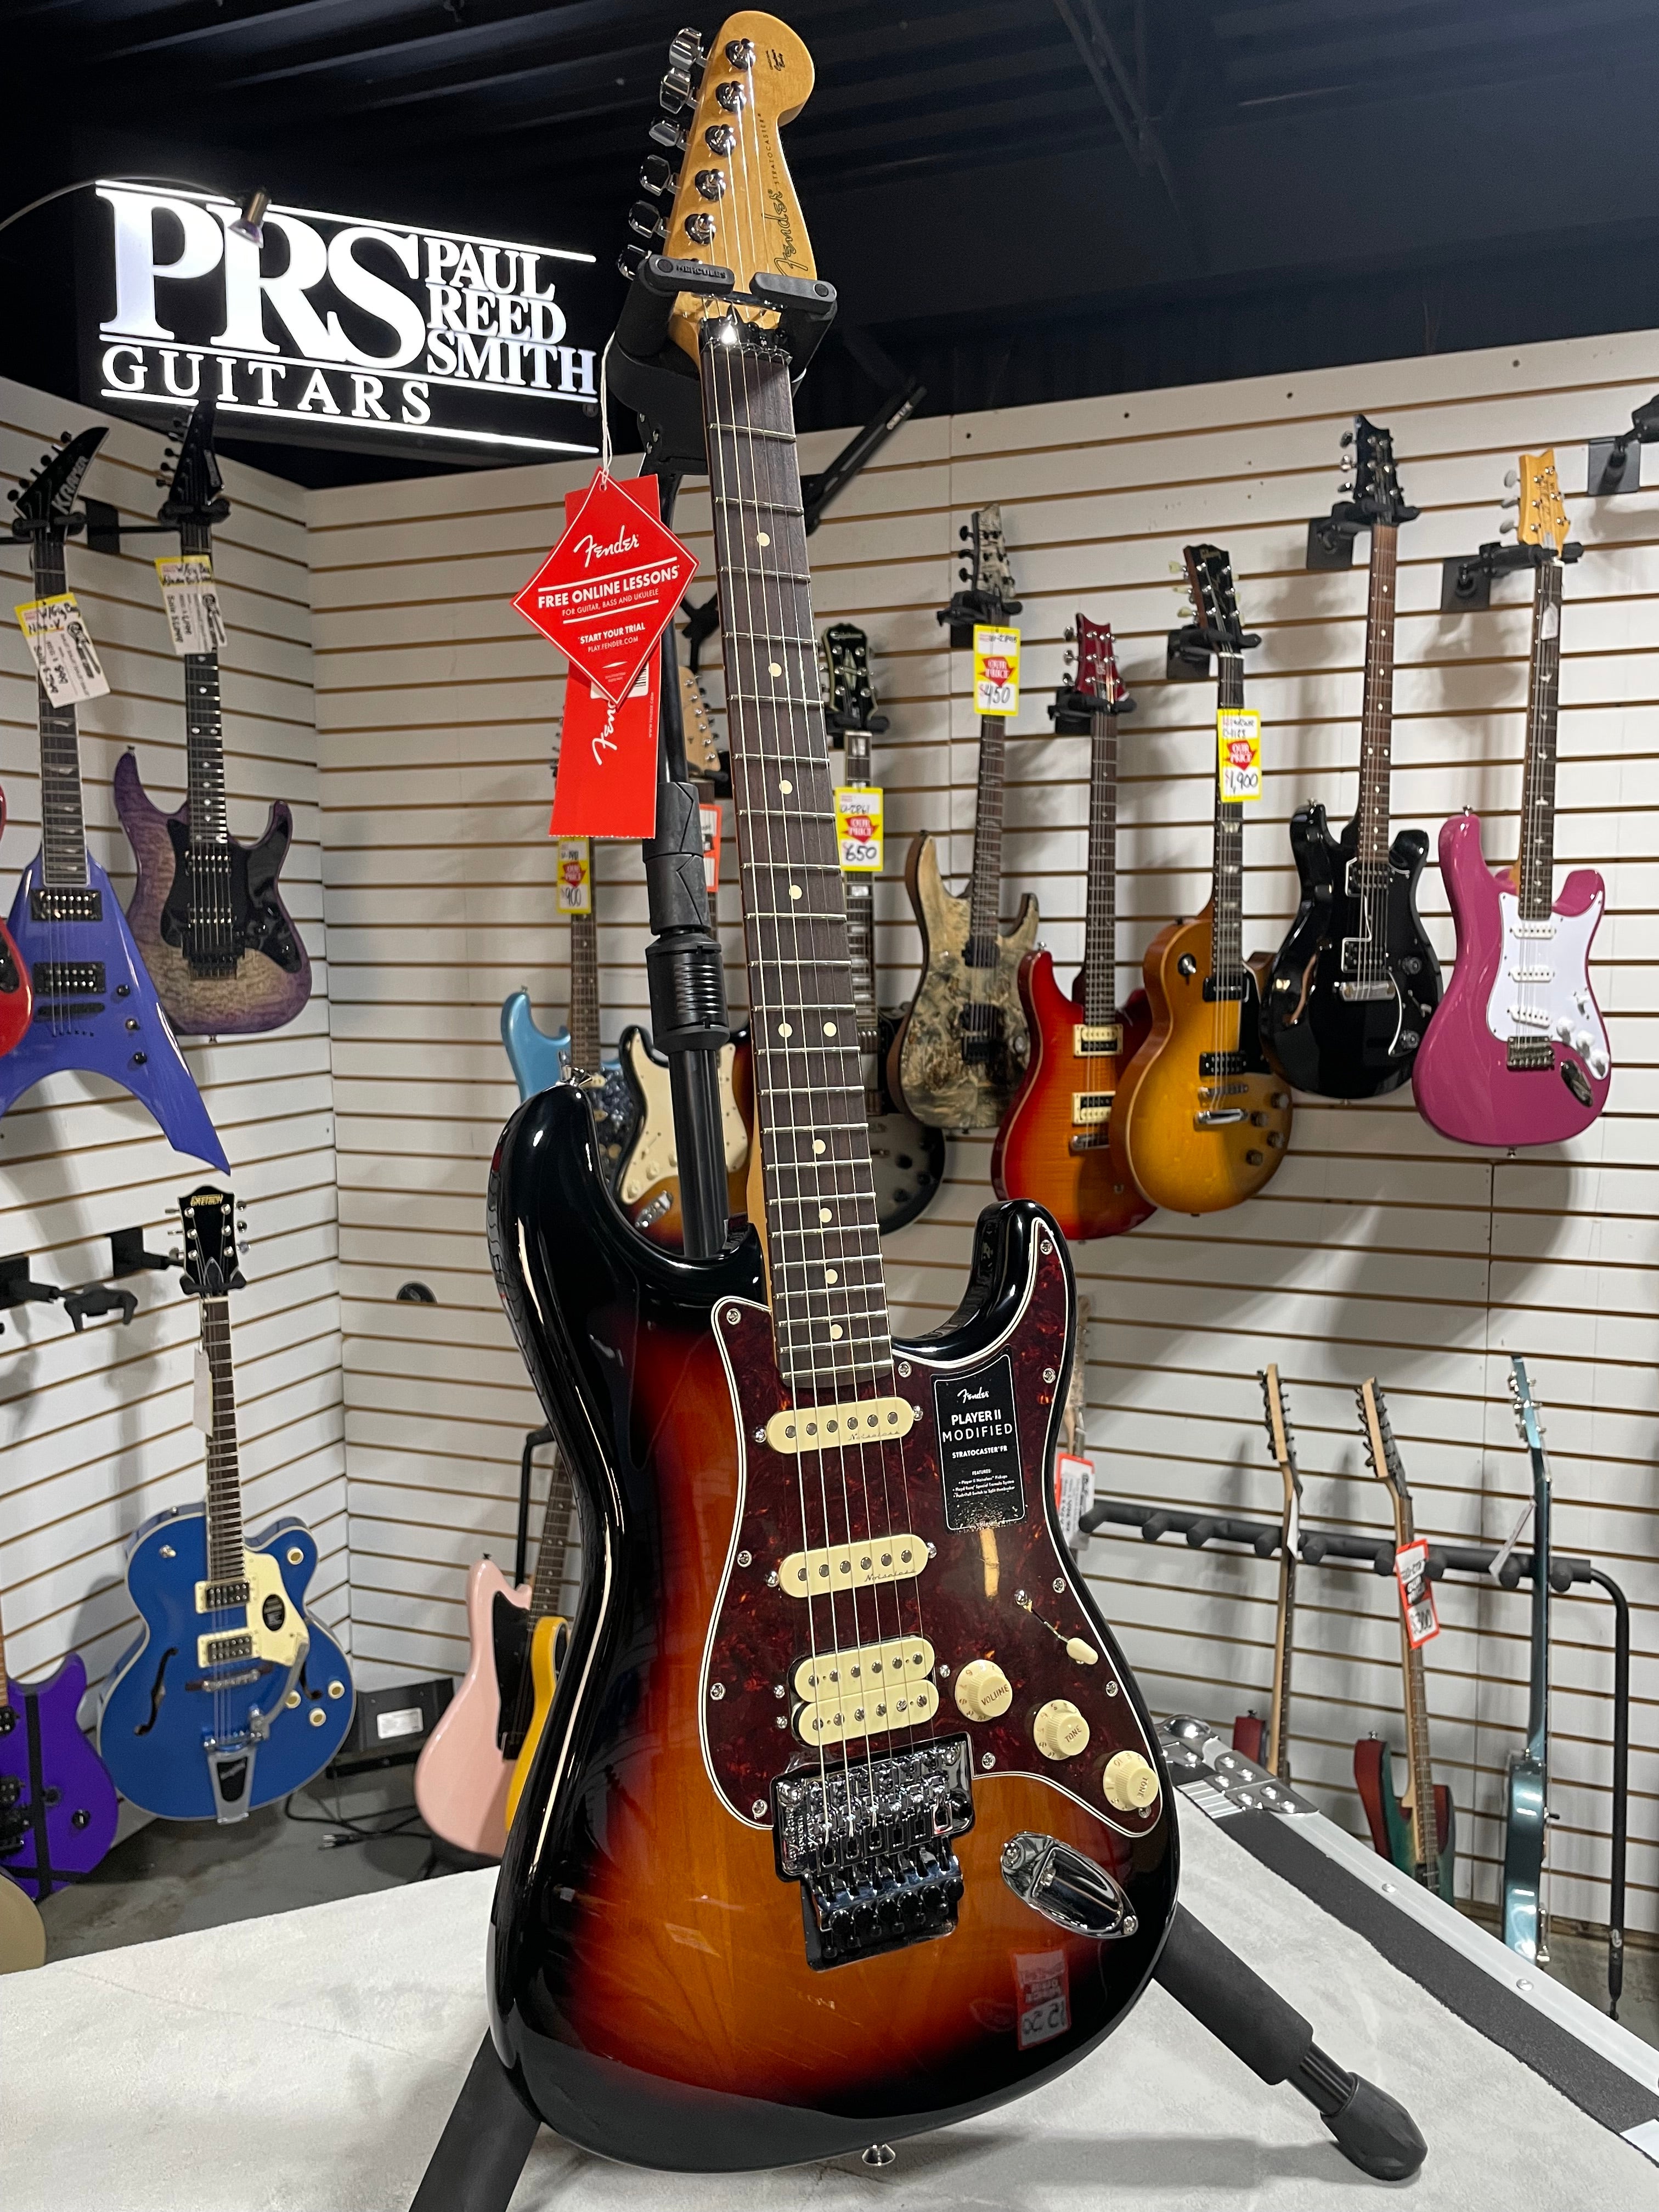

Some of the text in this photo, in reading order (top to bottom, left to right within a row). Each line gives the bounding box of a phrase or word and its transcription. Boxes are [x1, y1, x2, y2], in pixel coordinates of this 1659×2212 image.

[758, 117, 780, 185] STRATOCASTER
[761, 189, 809, 276] Fender
[95, 187, 426, 370] PRS
[424, 236, 555, 301] PAUL
[676, 264, 726, 279] HERCULES
[425, 282, 566, 345] REED
[425, 329, 596, 396] SMITH
[101, 345, 432, 425] GUITARS
[573, 524, 640, 568] Fender
[538, 566, 680, 608] FREE ONLINE LESSONS
[562, 588, 659, 617] FOR GUITAR, BASS AND UKULELE
[579, 622, 646, 645] START YOUR TRIAL
[588, 636, 639, 653] PLAY.FENDER.COM
[1230, 753, 1252, 764] PRICE
[1231, 743, 1250, 753] OUR
[848, 827, 872, 836] PRICE
[850, 818, 871, 827] OUR
[957, 1386, 989, 1404] Fender
[951, 1409, 1002, 1426] PLAYER II
[848, 1430, 900, 1441] Noiseless
[942, 1423, 1013, 1443] MODIFIED
[952, 1447, 1000, 1459] STRATOCASTER
[864, 1569, 917, 1582] Noiseless
[981, 1684, 1009, 1706] VOLUME
[1064, 1725, 1082, 1743] TONE
[1137, 1777, 1150, 1799] TONE
